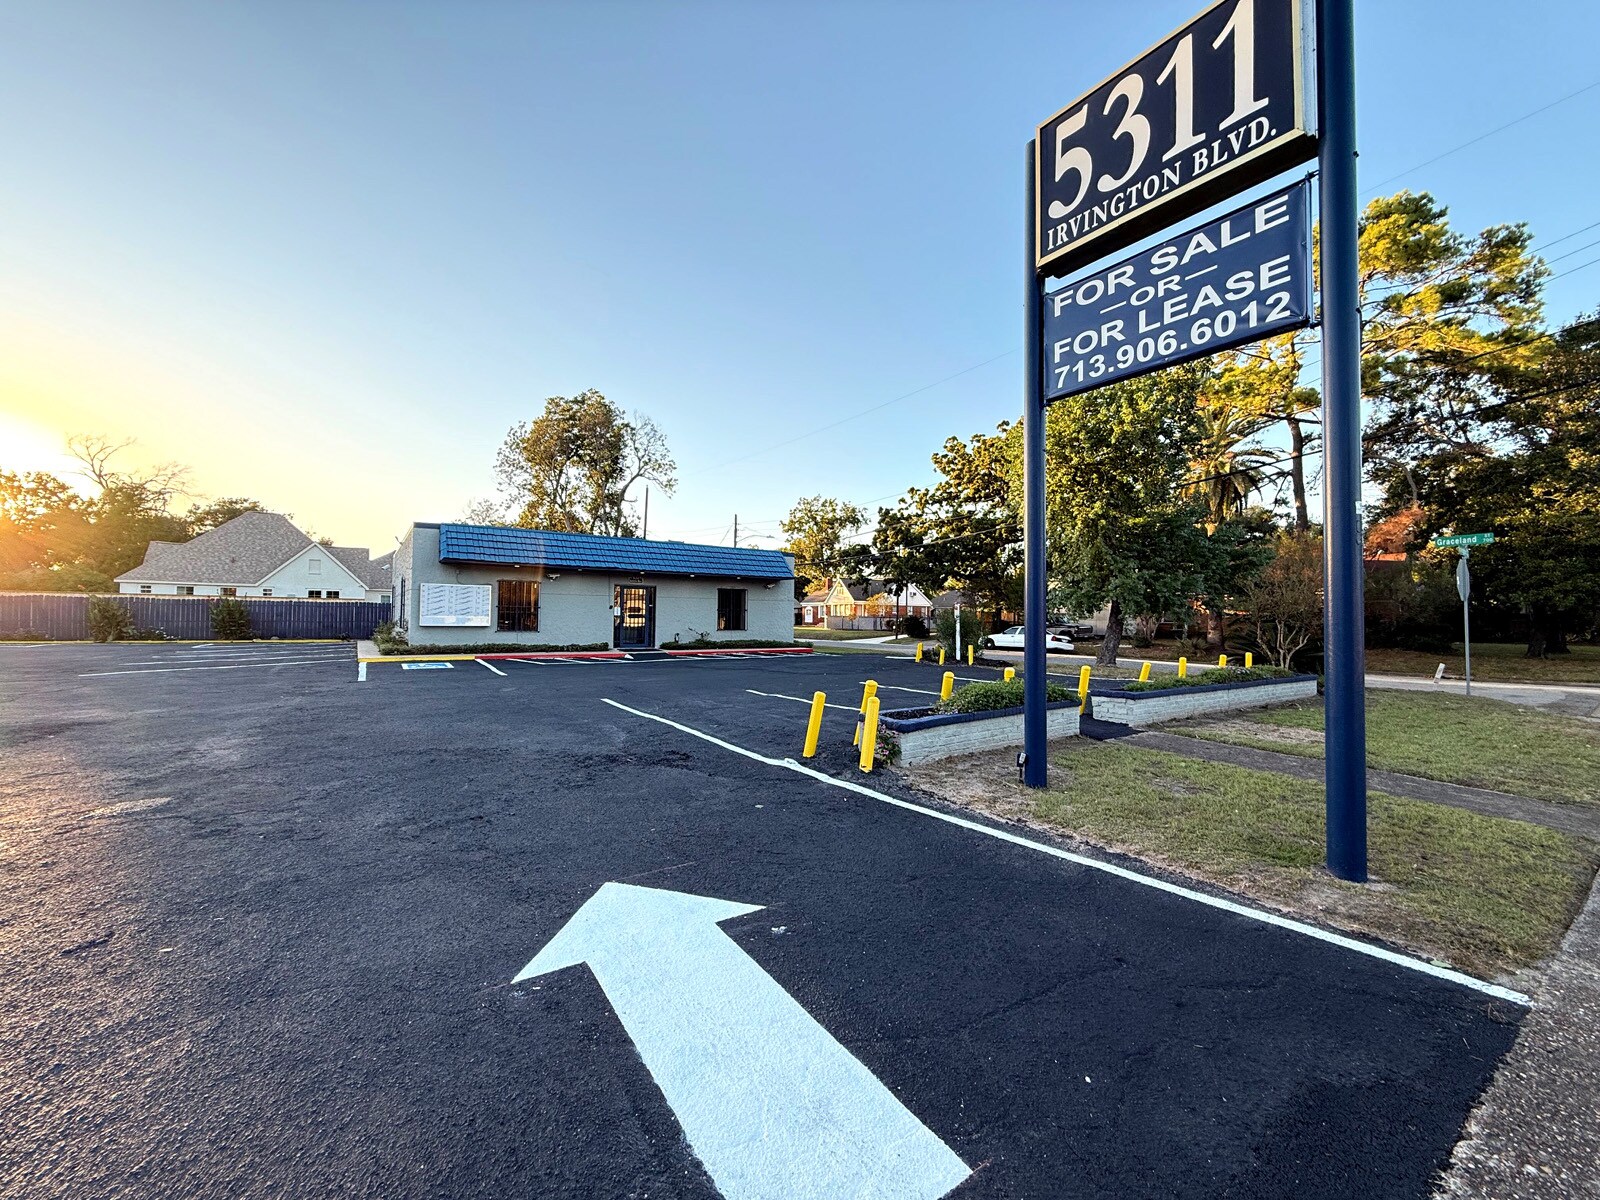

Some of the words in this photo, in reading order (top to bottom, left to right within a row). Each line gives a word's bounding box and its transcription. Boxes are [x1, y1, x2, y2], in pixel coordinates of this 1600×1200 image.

[1048, 0, 1269, 219] 5311
[1047, 163, 1181, 251] IRVINGTON
[1192, 116, 1277, 177] BLVD.
[1054, 265, 1136, 317] FOR
[1150, 194, 1290, 276] SALE
[1054, 319, 1126, 363] FOR
[1138, 255, 1291, 333] LEASE
[1054, 291, 1291, 390] 713.906.6012
[1436, 536, 1477, 546] Graceland
